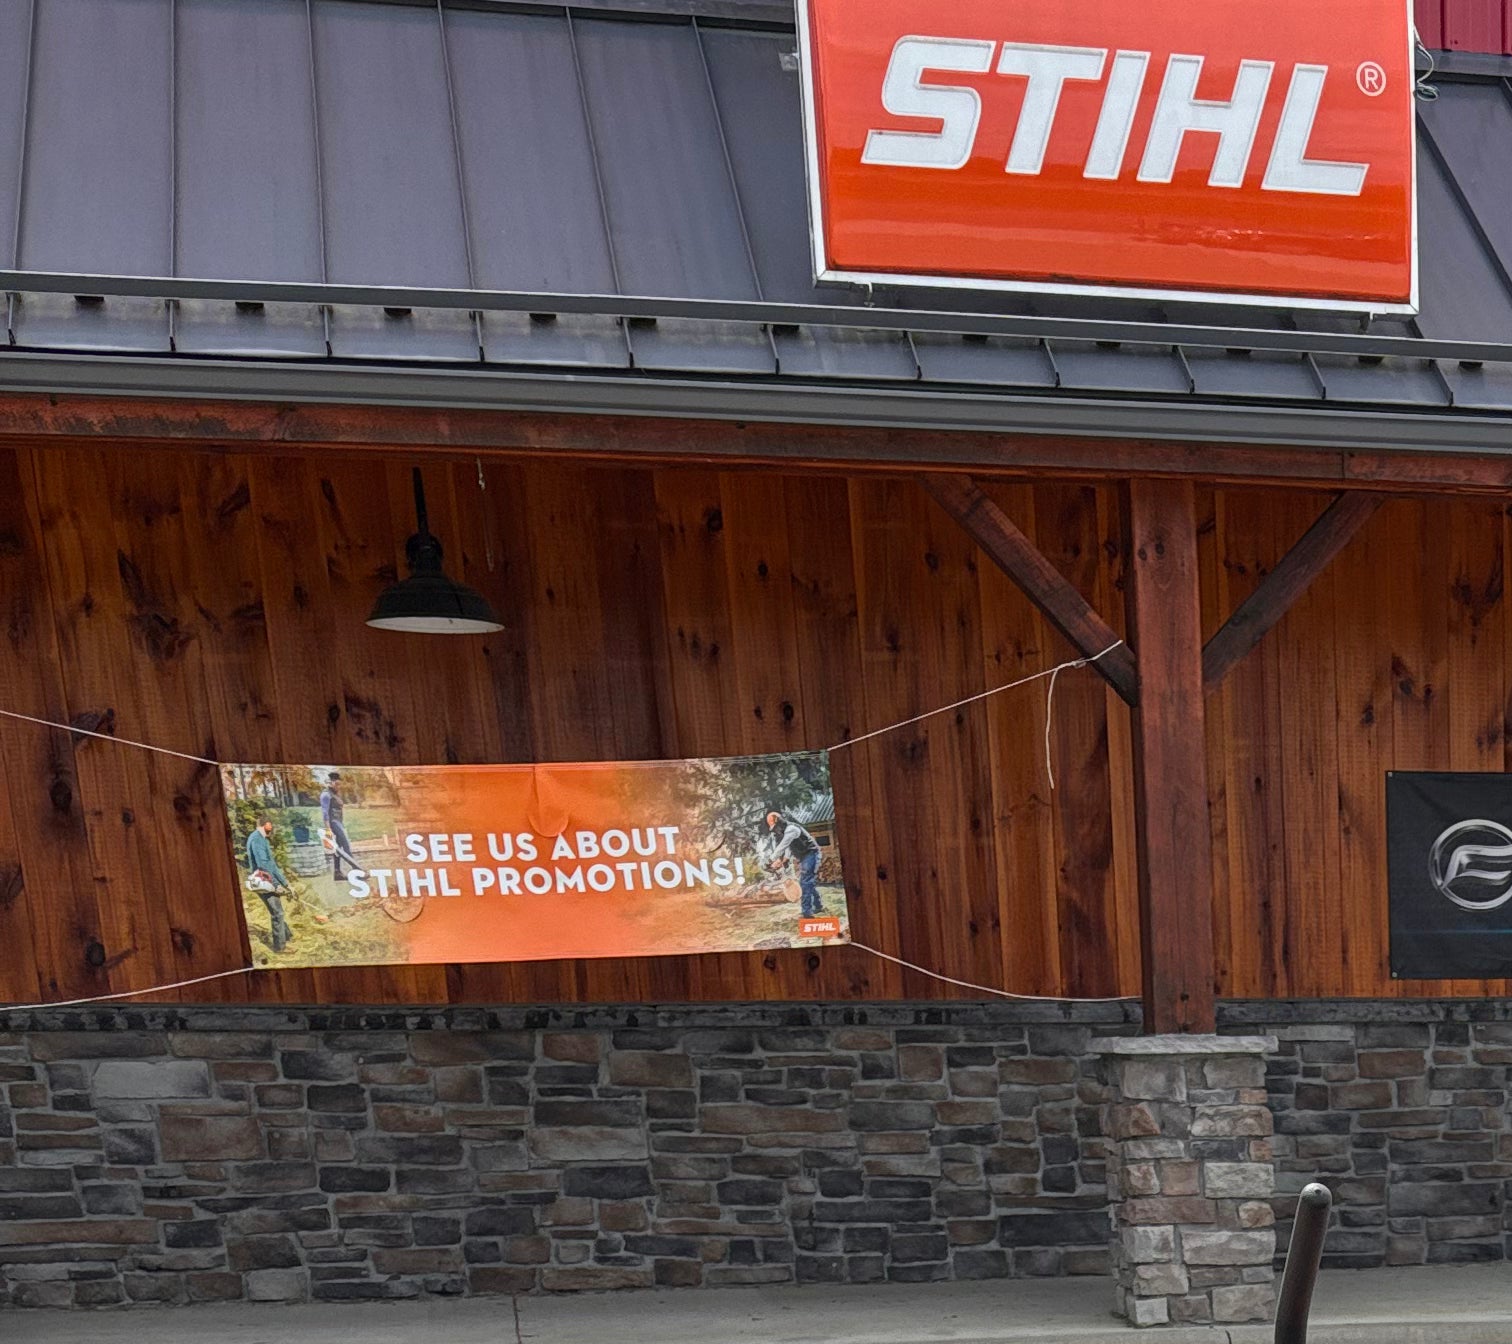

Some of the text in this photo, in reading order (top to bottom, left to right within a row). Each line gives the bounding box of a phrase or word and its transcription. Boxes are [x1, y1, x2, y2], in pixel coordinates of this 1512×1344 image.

[861, 35, 1369, 195] STIHL
[405, 826, 680, 863] SEE US ABOUT
[347, 857, 746, 899] STIHL PROMOTIONS!
[803, 922, 836, 932] STIHL
